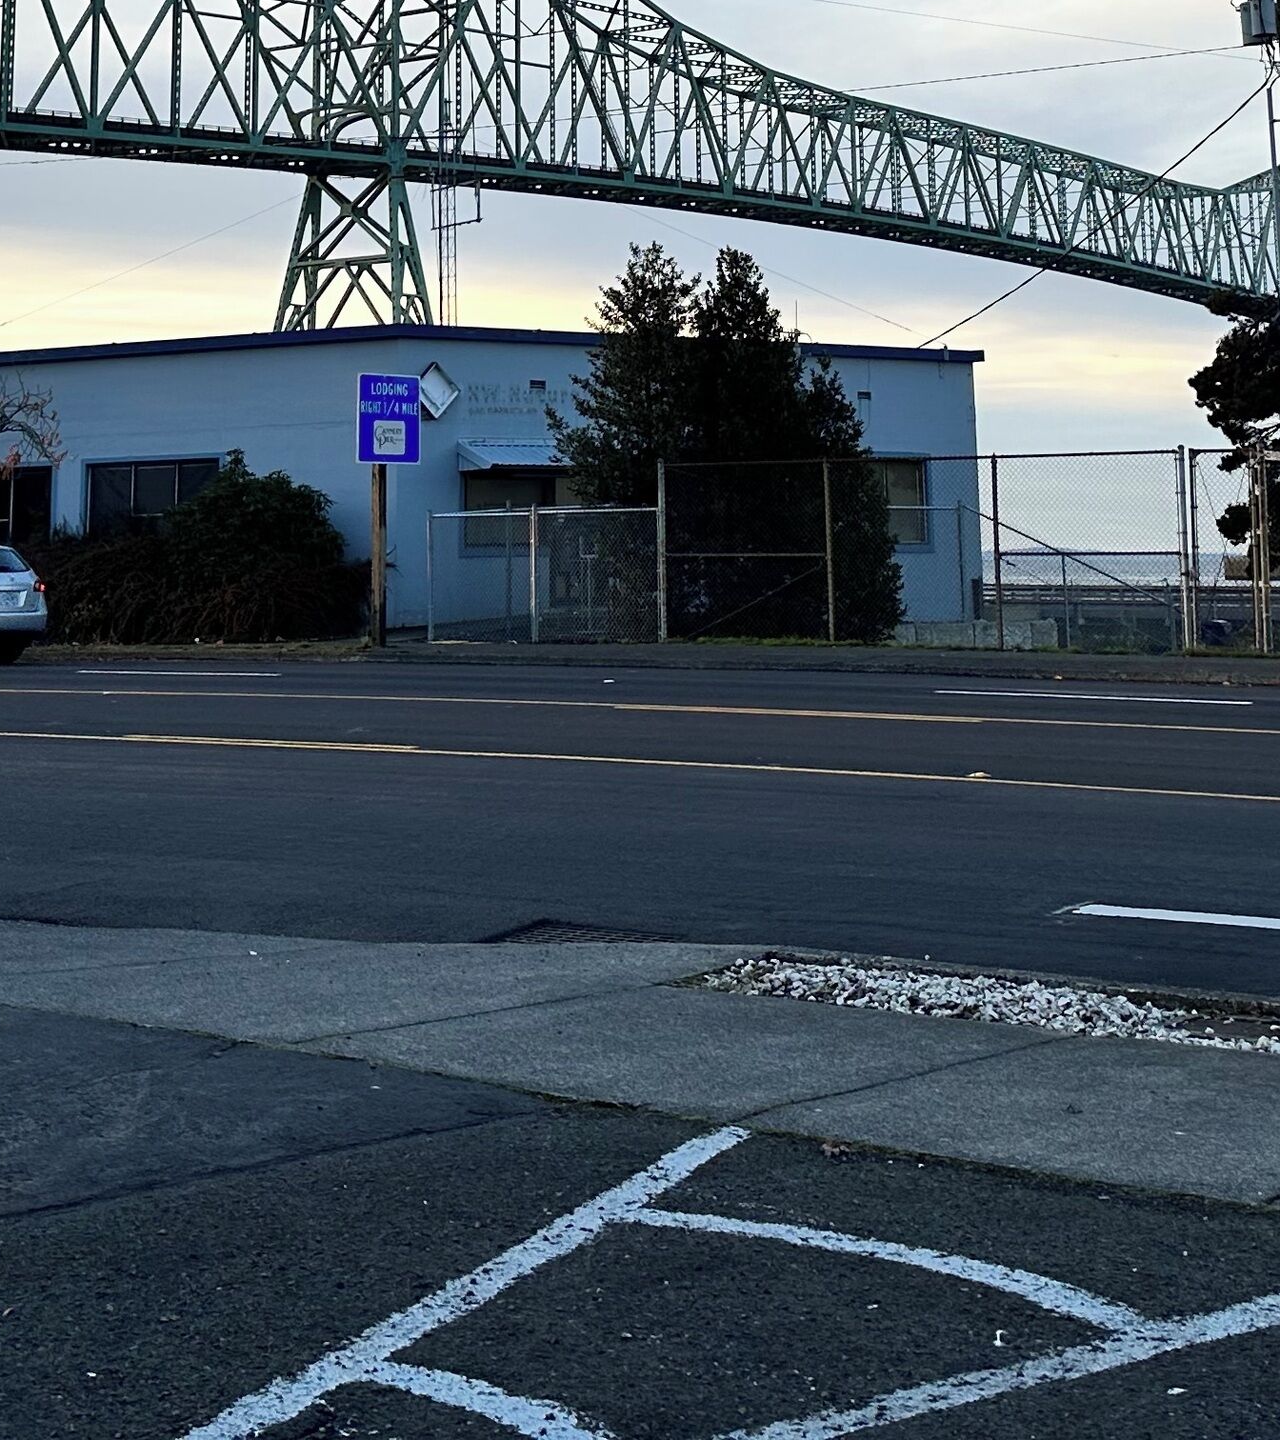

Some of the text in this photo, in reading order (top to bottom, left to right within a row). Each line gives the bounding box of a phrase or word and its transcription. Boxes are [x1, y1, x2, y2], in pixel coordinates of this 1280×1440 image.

[371, 382, 409, 397] LODGING
[360, 399, 418, 417] RIGHT 1/4 MILE
